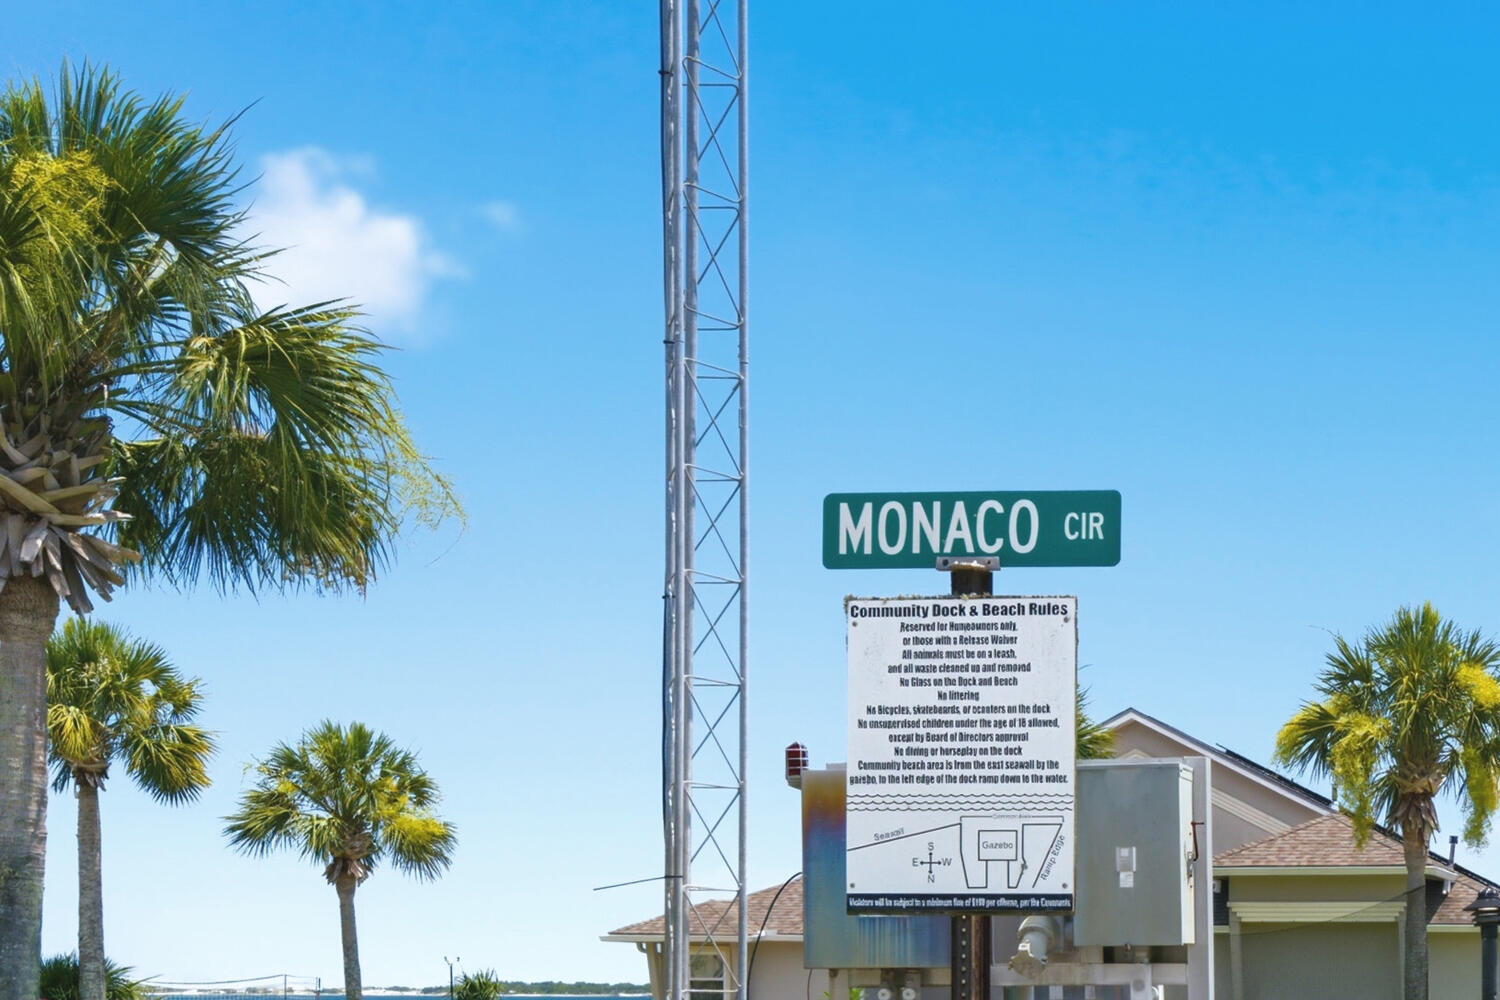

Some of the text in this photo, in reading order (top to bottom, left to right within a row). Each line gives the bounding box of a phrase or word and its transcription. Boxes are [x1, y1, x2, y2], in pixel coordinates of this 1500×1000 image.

[838, 499, 1104, 555] MONACO CIR
[851, 603, 1068, 618] Community Dock & Beach Rules
[900, 622, 935, 632] Reserved
[937, 622, 947, 631] for
[913, 636, 933, 645] those
[935, 636, 951, 645] with
[954, 637, 957, 645] a
[959, 635, 989, 645] Release
[991, 635, 1017, 644] Waiver
[903, 650, 912, 659] All
[914, 650, 943, 659] animals
[945, 650, 964, 659] must
[966, 650, 975, 658] be
[888, 663, 1031, 673] and all waste cleaned up and removed
[900, 678, 909, 686] No
[911, 677, 931, 687] Glass
[944, 677, 956, 686] the
[958, 677, 976, 686] Dock
[978, 677, 992, 686] and
[994, 676, 1017, 686] Beach
[937, 691, 980, 701] No littering
[867, 706, 876, 714] No
[963, 706, 970, 714] or
[1019, 704, 1030, 713] the
[1032, 704, 1050, 713] dock
[858, 719, 867, 728] No
[870, 719, 920, 729] unsupervised
[922, 719, 953, 728] children
[955, 719, 977, 728] under
[980, 719, 991, 727] the
[994, 720, 1007, 728] age
[1009, 718, 1016, 727] of
[889, 732, 1028, 743] except by Board of Directors approval
[894, 747, 903, 756] No
[906, 747, 929, 757] diving
[931, 748, 938, 756] or
[940, 746, 978, 756] horseplay
[990, 747, 1002, 755] the
[1004, 746, 1022, 755] dock
[858, 760, 1059, 770] Community beach area is from the east seawall by the
[879, 775, 886, 783] to
[888, 775, 899, 783] the
[902, 775, 914, 783] left
[916, 774, 935, 785] edge
[937, 774, 943, 783] of
[945, 775, 957, 783] the
[959, 774, 977, 783] dock
[979, 776, 998, 784] ramp
[1001, 774, 1021, 783] down
[1023, 775, 1029, 783] to
[1032, 774, 1043, 783] the
[928, 842, 934, 851] S
[982, 841, 1013, 849] Gazebo
[912, 858, 918, 866] E
[942, 858, 952, 866] W
[1040, 835, 1065, 881] Ramp Edge
[928, 875, 935, 883] N
